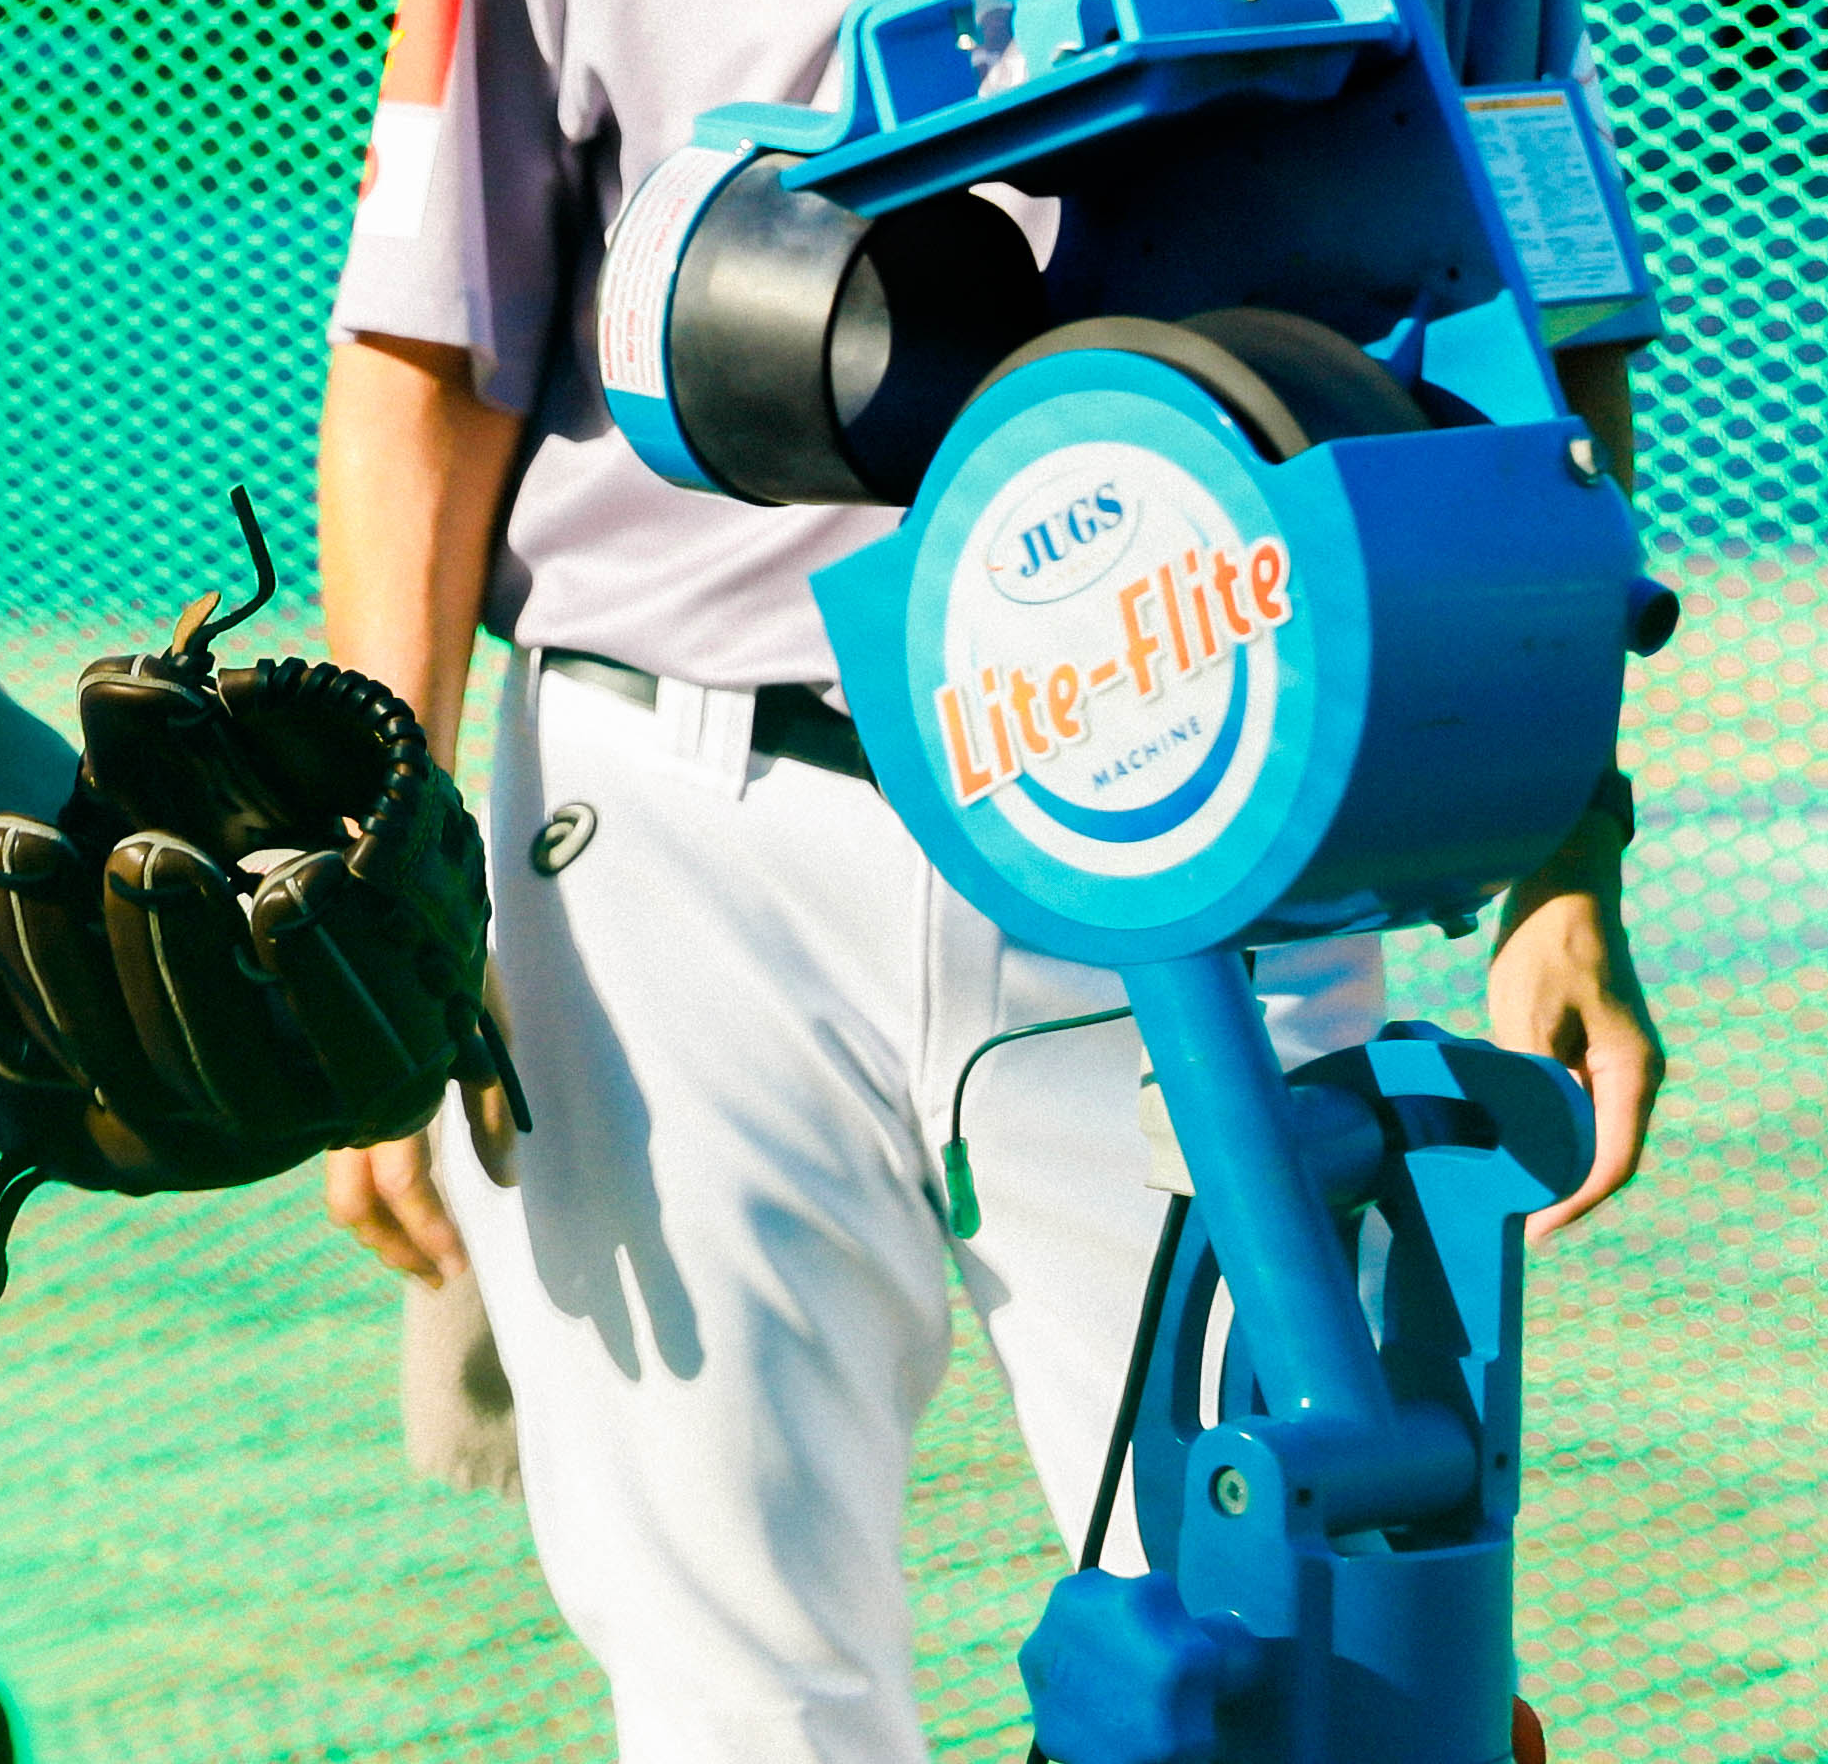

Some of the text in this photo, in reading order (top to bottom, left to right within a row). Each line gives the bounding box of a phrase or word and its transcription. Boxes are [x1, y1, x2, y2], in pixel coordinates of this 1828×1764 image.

[1020, 481, 1124, 577] JUGS
[940, 544, 1284, 800] Lite-Flite
[1092, 716, 1202, 792] MACHINE
